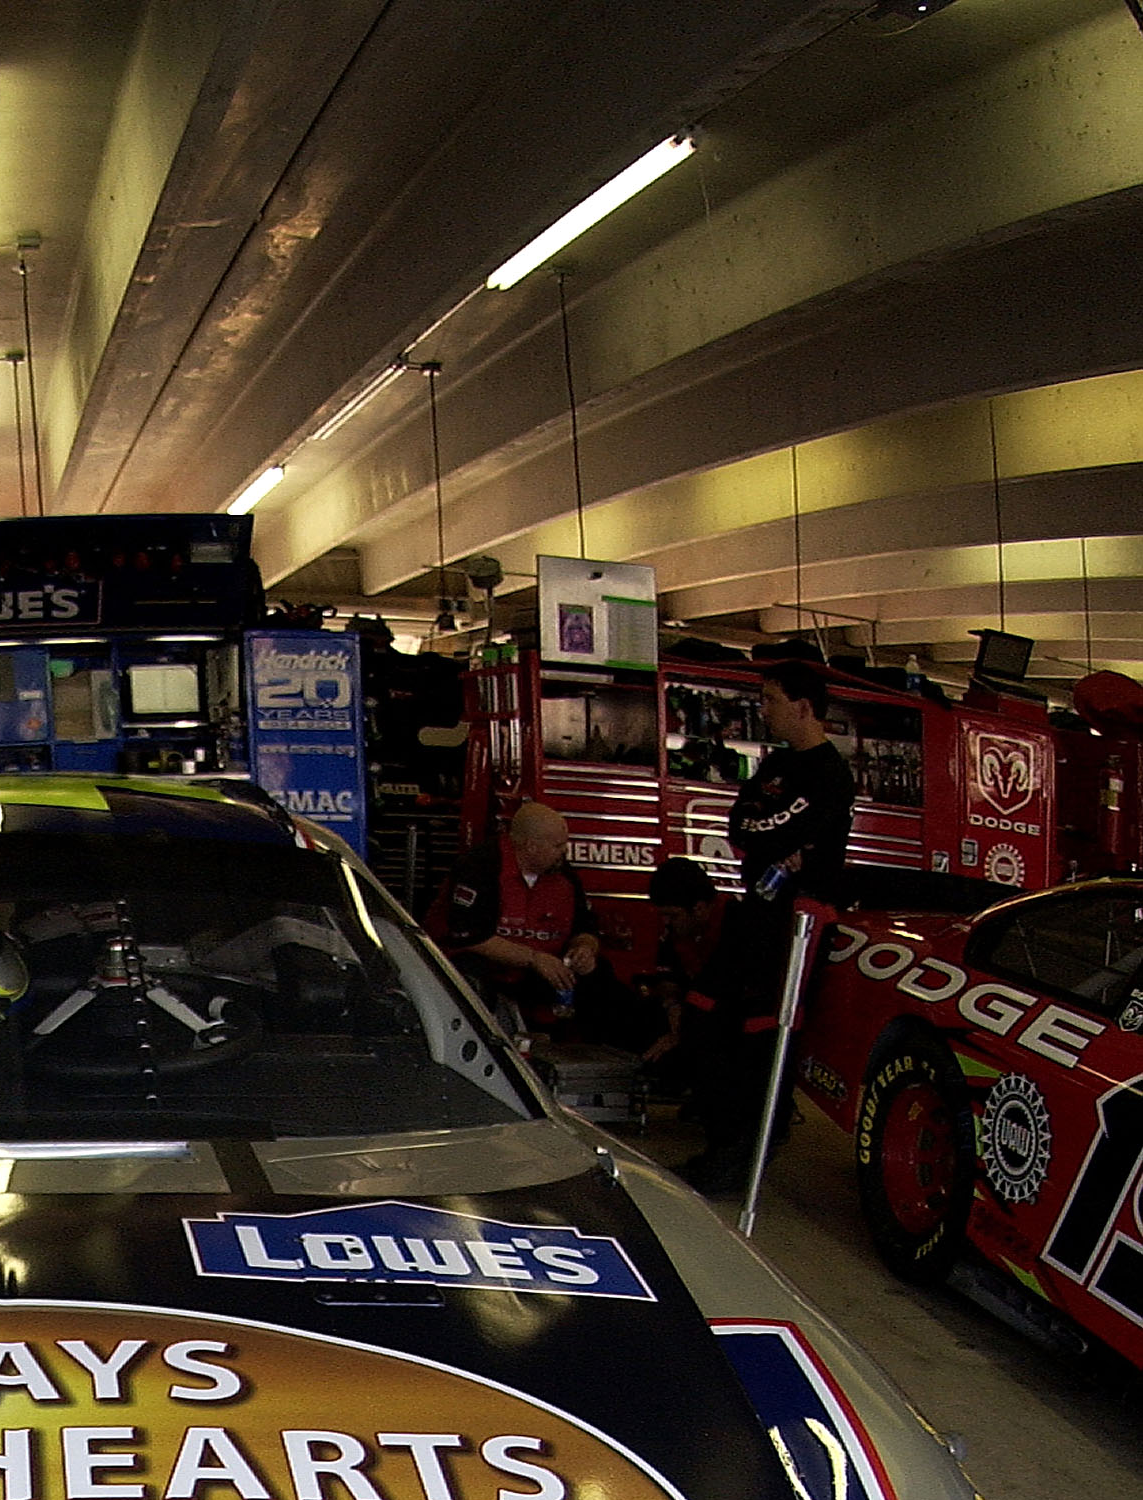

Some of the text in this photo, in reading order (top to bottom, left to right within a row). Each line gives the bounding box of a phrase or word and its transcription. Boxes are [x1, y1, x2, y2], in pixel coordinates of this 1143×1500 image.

[255, 670, 351, 709] 20
[257, 709, 349, 720] YEARS
[969, 813, 1042, 837] DODGE
[565, 841, 655, 865] IEMENS
[827, 923, 1108, 1069] DODGE
[234, 1224, 600, 1286] LOWE'S
